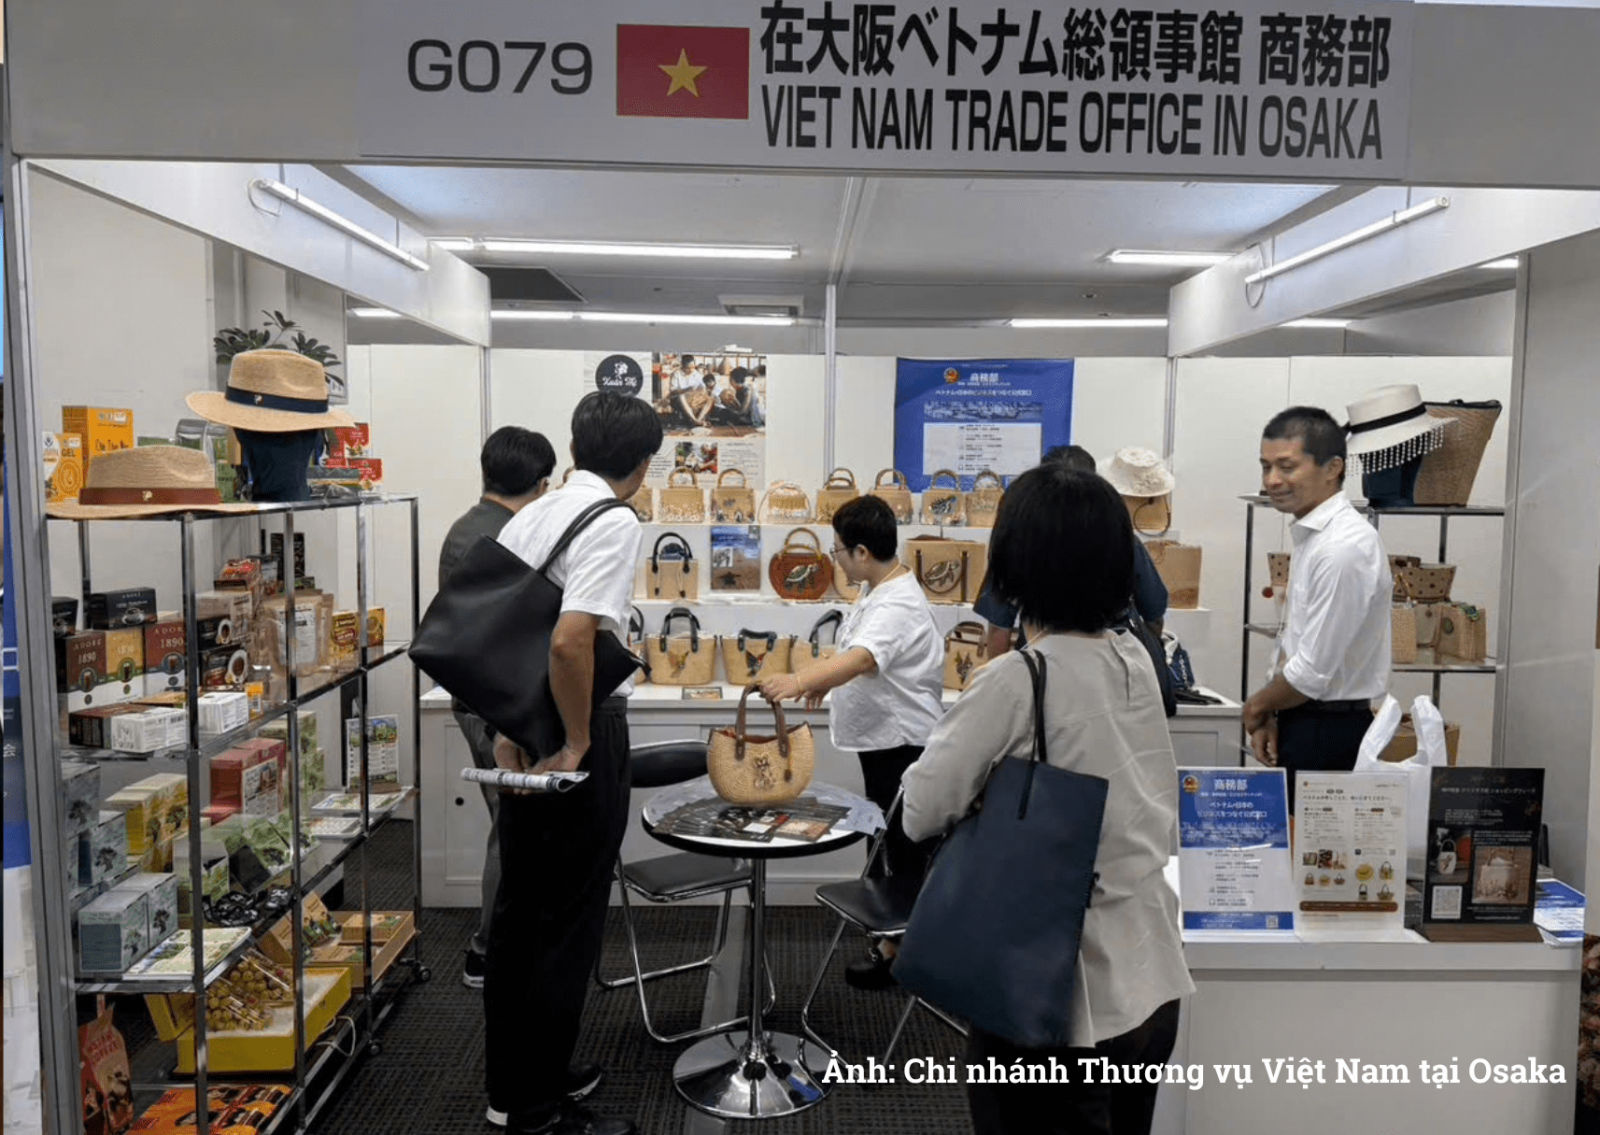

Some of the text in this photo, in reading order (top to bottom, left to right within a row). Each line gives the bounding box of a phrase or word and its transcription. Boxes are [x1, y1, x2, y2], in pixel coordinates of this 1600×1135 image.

[760, 0, 1392, 89] 在大阪ベトナム総領事館 商務部
[761, 85, 1383, 160] VIET NAM TRADE OFFICE IN OSAKA
[154, 625, 185, 636] ADOR
[160, 637, 185, 649] 1890
